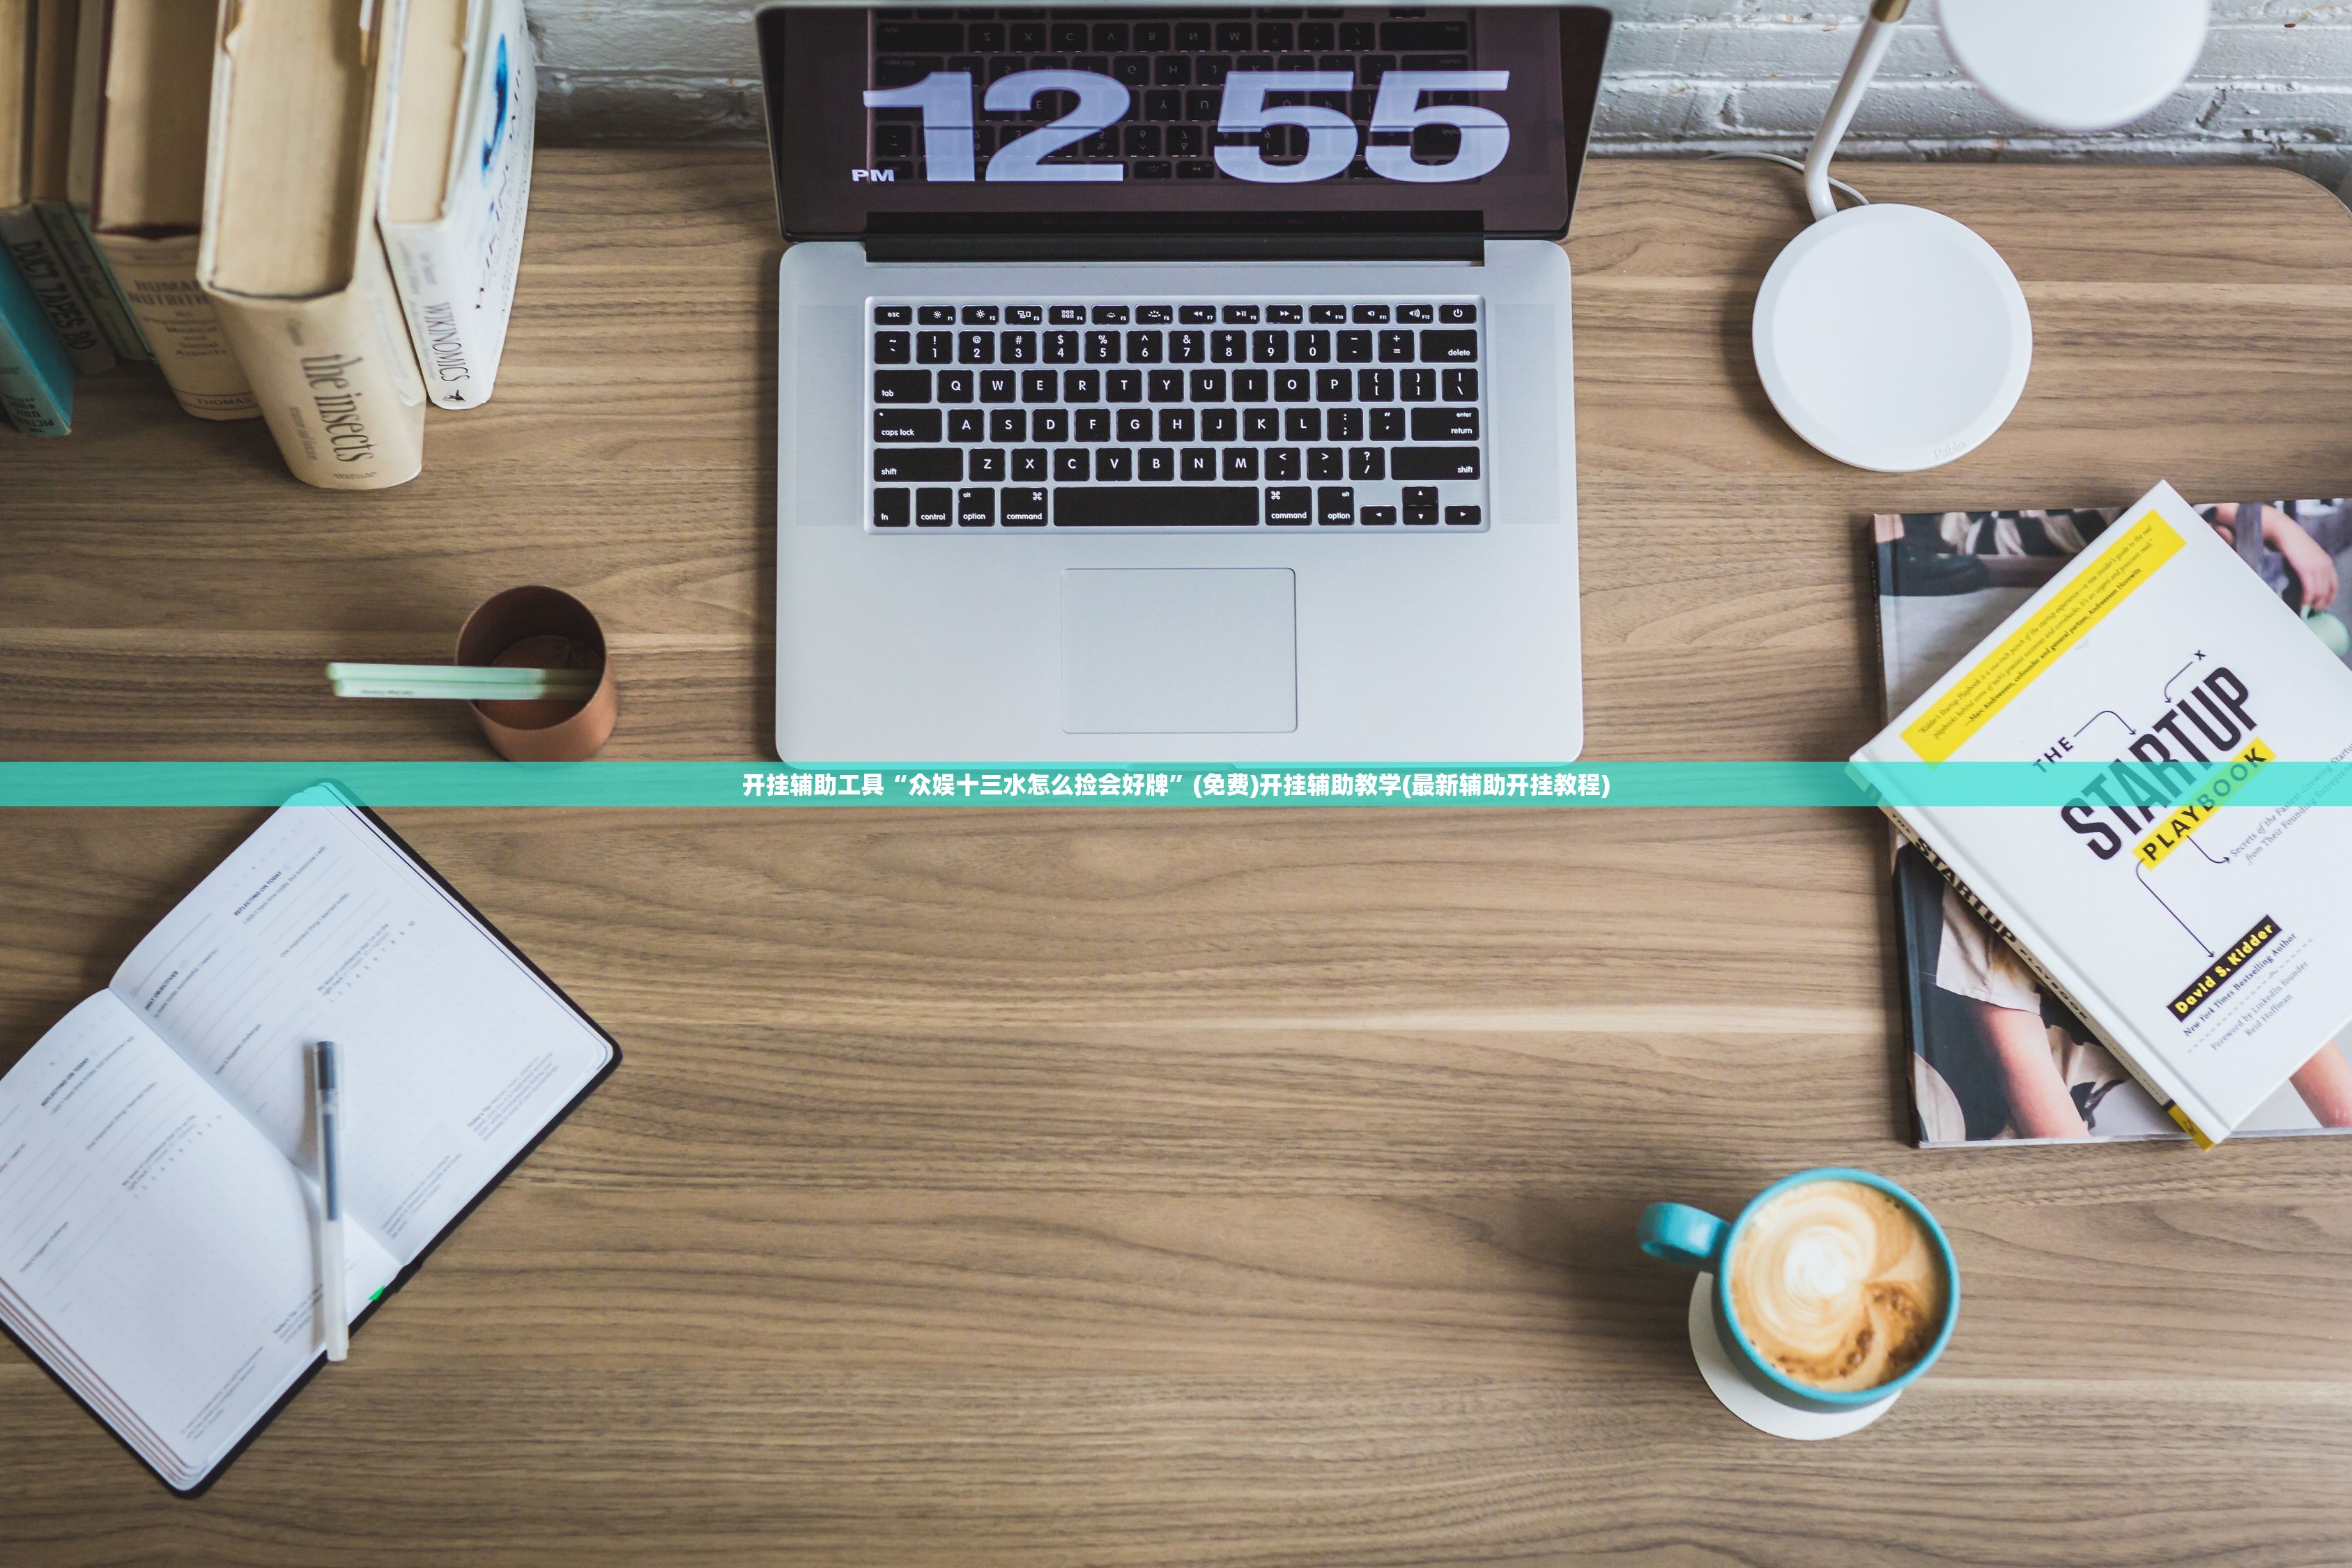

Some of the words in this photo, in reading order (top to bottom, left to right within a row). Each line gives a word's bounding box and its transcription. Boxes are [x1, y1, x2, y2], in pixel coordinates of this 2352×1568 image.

[863, 69, 1131, 181] 12
[1213, 71, 1510, 183] 55
[852, 169, 894, 182] PM
[11, 240, 59, 277] DUCT
[36, 282, 85, 328] TAPES
[300, 354, 363, 388] the
[424, 302, 470, 381] WIKINOMICS
[932, 348, 937, 358] 1
[974, 348, 980, 358] 2
[1015, 348, 1022, 358] 3
[1057, 348, 1064, 357] 4
[1100, 348, 1106, 357] 5
[1142, 348, 1148, 357] 6
[1184, 348, 1190, 357] 7
[1226, 348, 1232, 356] 8
[1268, 348, 1274, 356] 9
[1309, 347, 1316, 356] 0
[951, 381, 960, 390] Q
[992, 381, 1003, 390] W
[1037, 381, 1043, 390] E
[1079, 381, 1086, 390] R
[1121, 381, 1128, 390] T
[1163, 380, 1170, 390] Y
[1204, 380, 1213, 390] U
[1249, 380, 1252, 390] I
[1288, 380, 1296, 390] O
[1331, 379, 1338, 389] P
[314, 394, 380, 462] insects
[962, 420, 971, 429] A
[1006, 420, 1012, 429] S
[1047, 420, 1055, 429] D
[1090, 420, 1096, 429] F
[1131, 420, 1139, 429] G
[1173, 420, 1181, 429] H
[1216, 419, 1222, 429] J
[1258, 419, 1266, 429] K
[1300, 419, 1307, 428] L
[1933, 440, 1966, 459] Pablo
[984, 459, 992, 469] Z
[1026, 459, 1034, 468] X
[1068, 459, 1076, 469] C
[1110, 459, 1119, 468] V
[1153, 459, 1160, 468] B
[1194, 459, 1203, 468] N
[1236, 458, 1246, 468] M
[1328, 512, 1350, 521] option
[2032, 737, 2074, 774] THE
[2061, 667, 2257, 860] STARTUP
[2143, 748, 2268, 861] PLAYBOOK
[2231, 834, 2257, 856] Secrets
[2257, 823, 2266, 834] of
[2264, 815, 2276, 826] the
[2245, 846, 2263, 865] from
[2261, 829, 2282, 845] Their
[2281, 799, 2315, 829] Founding
[1916, 837, 2017, 944] STARTUP
[2019, 948, 2089, 1021] PLAYBOOK
[2175, 976, 2215, 1013] David
[2215, 966, 2230, 977] S.
[2227, 925, 2271, 964] Kidder
[2183, 1022, 2199, 1036] New
[2199, 1008, 2215, 1021] York
[2213, 991, 2234, 1008] Times
[2233, 956, 2273, 990] Bestselling
[2273, 935, 2296, 955] Author
[2211, 1020, 2244, 1050] Foreword
[2241, 1013, 2253, 1022] by
[2251, 986, 2282, 1013] LinkedIn
[2281, 962, 2307, 986] founder
[2245, 1020, 2262, 1036] Reid
[2261, 995, 2292, 1022] Hoffman
